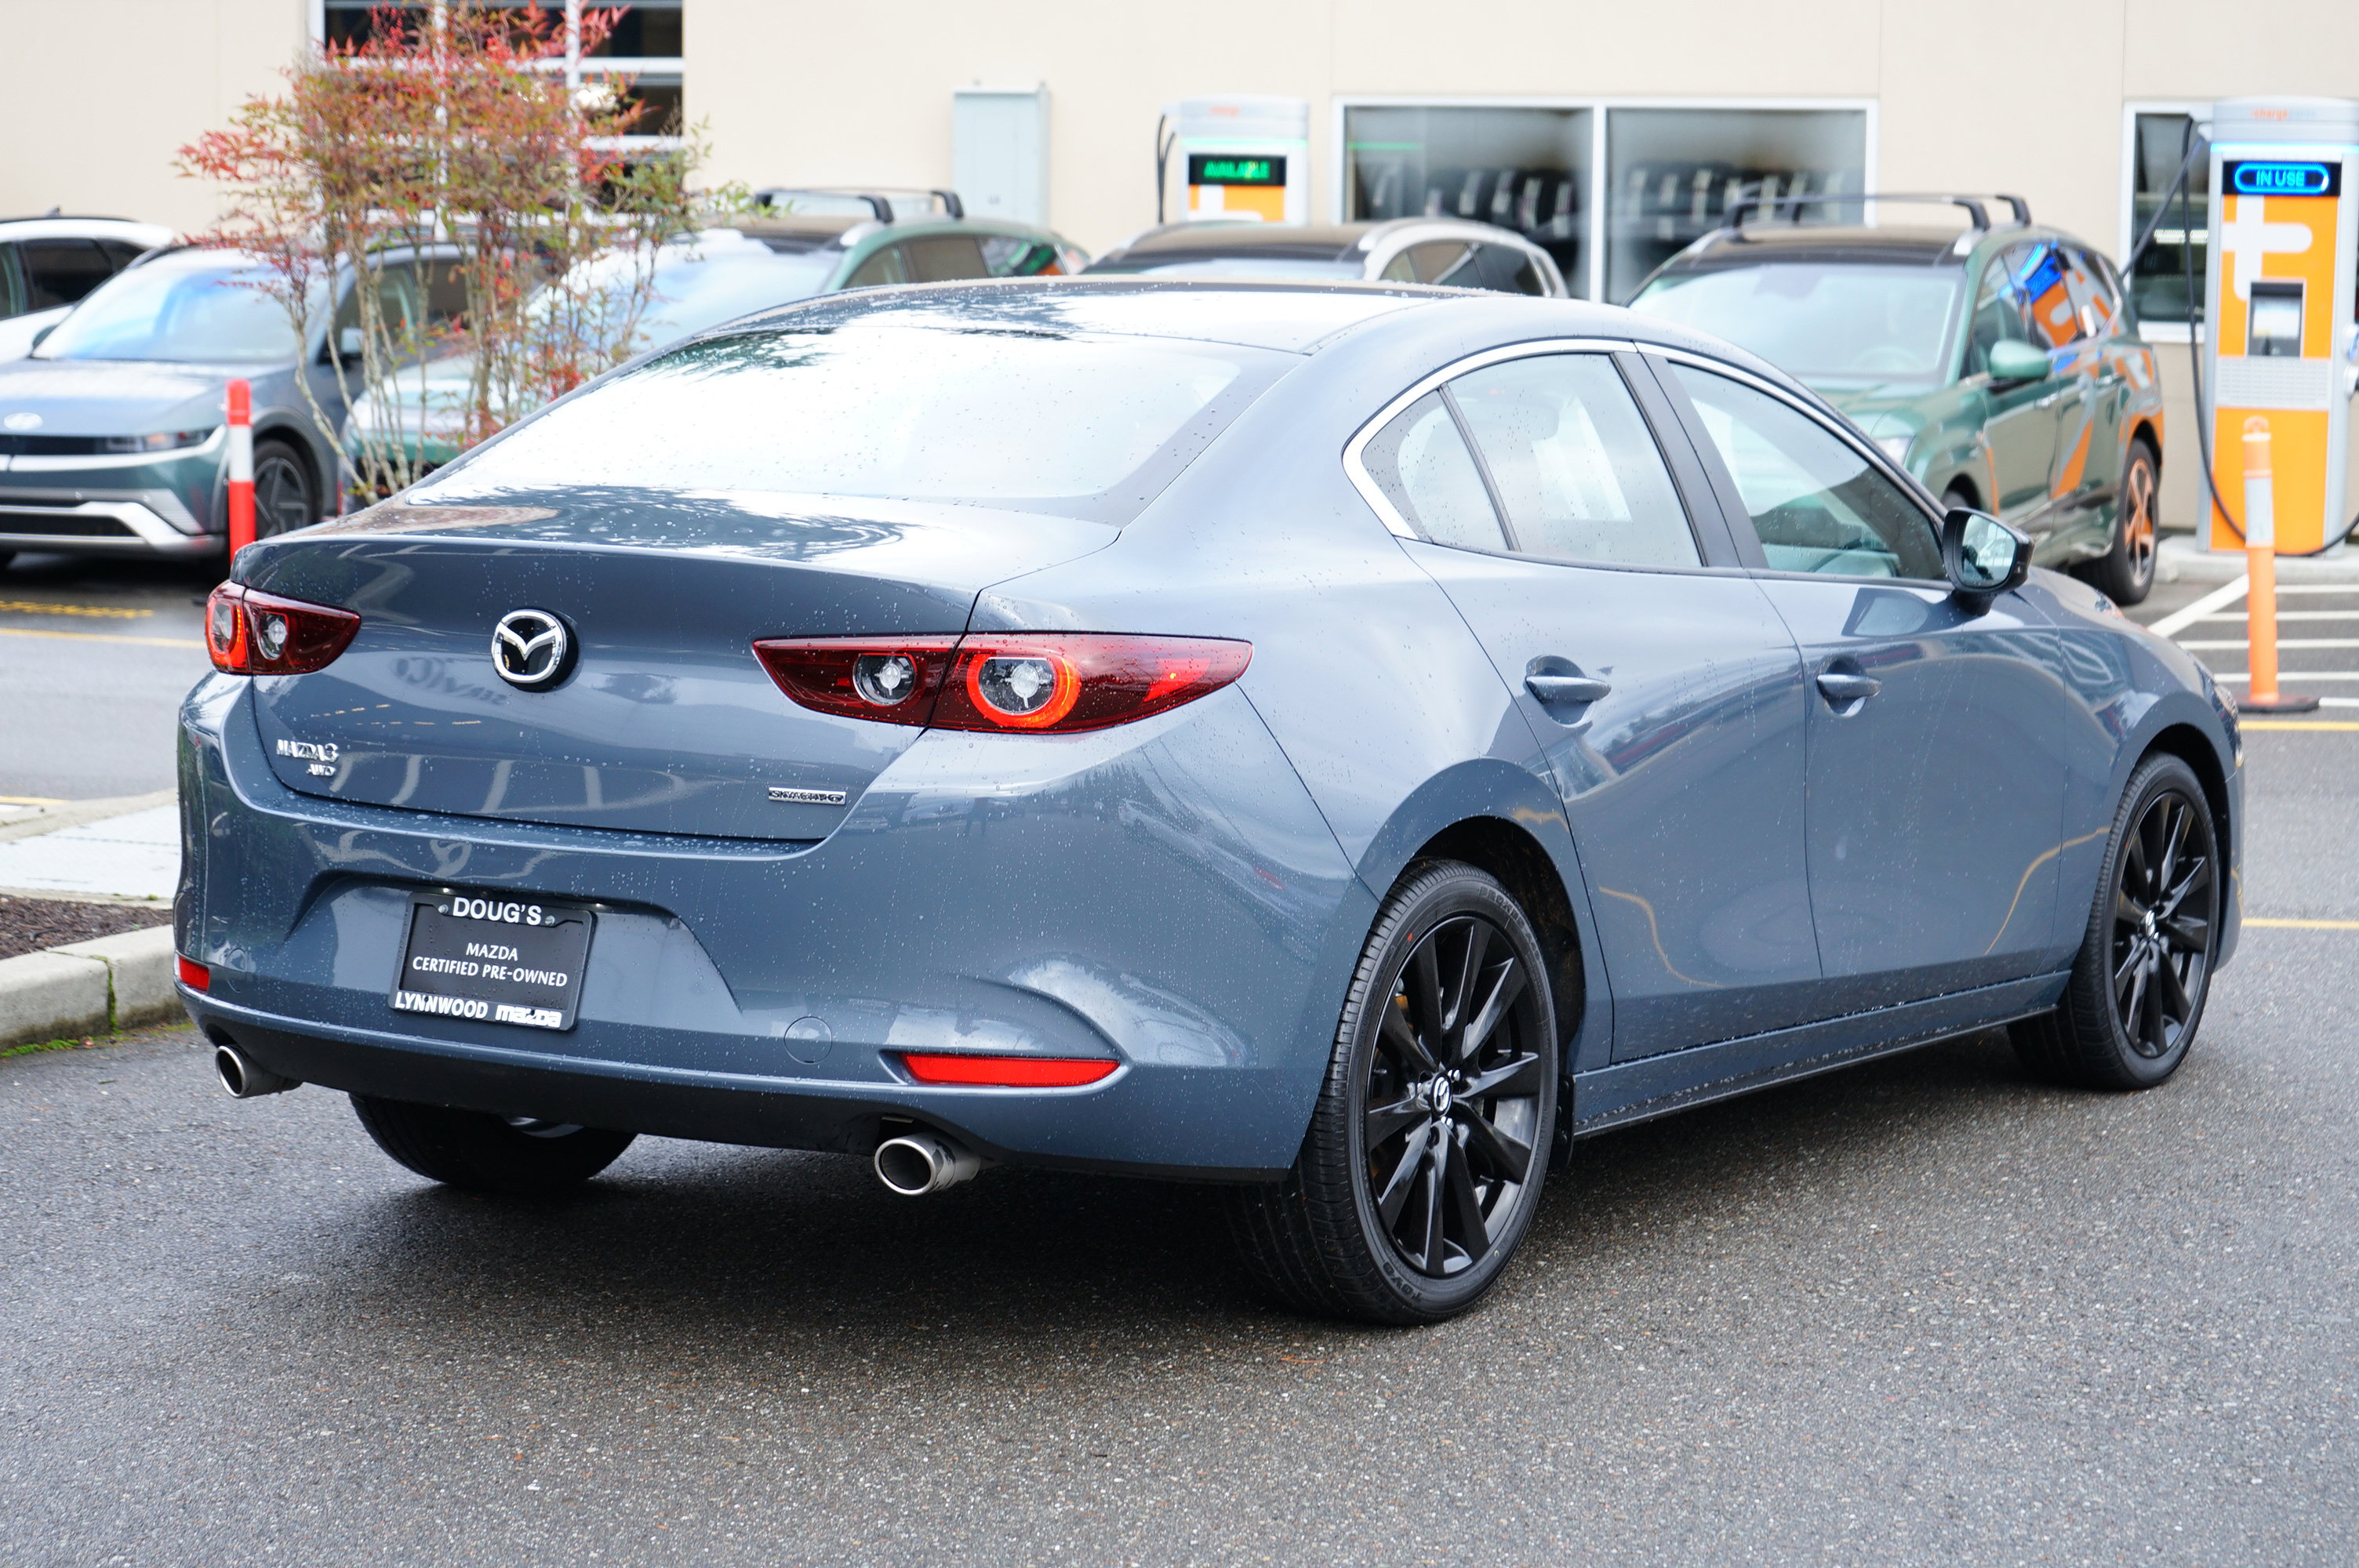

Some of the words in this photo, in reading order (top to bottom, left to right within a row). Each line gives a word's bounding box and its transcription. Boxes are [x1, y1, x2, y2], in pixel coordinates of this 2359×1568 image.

[2255, 169, 2272, 187] IN
[2275, 169, 2306, 187] USE
[276, 739, 340, 762] MAZDA3
[453, 897, 542, 926] DOUG'S
[466, 942, 518, 962] MAZDA
[413, 956, 479, 977] CERTIFIED
[482, 964, 568, 987] PRE-OWNED
[394, 992, 489, 1019] LYNNWOOD
